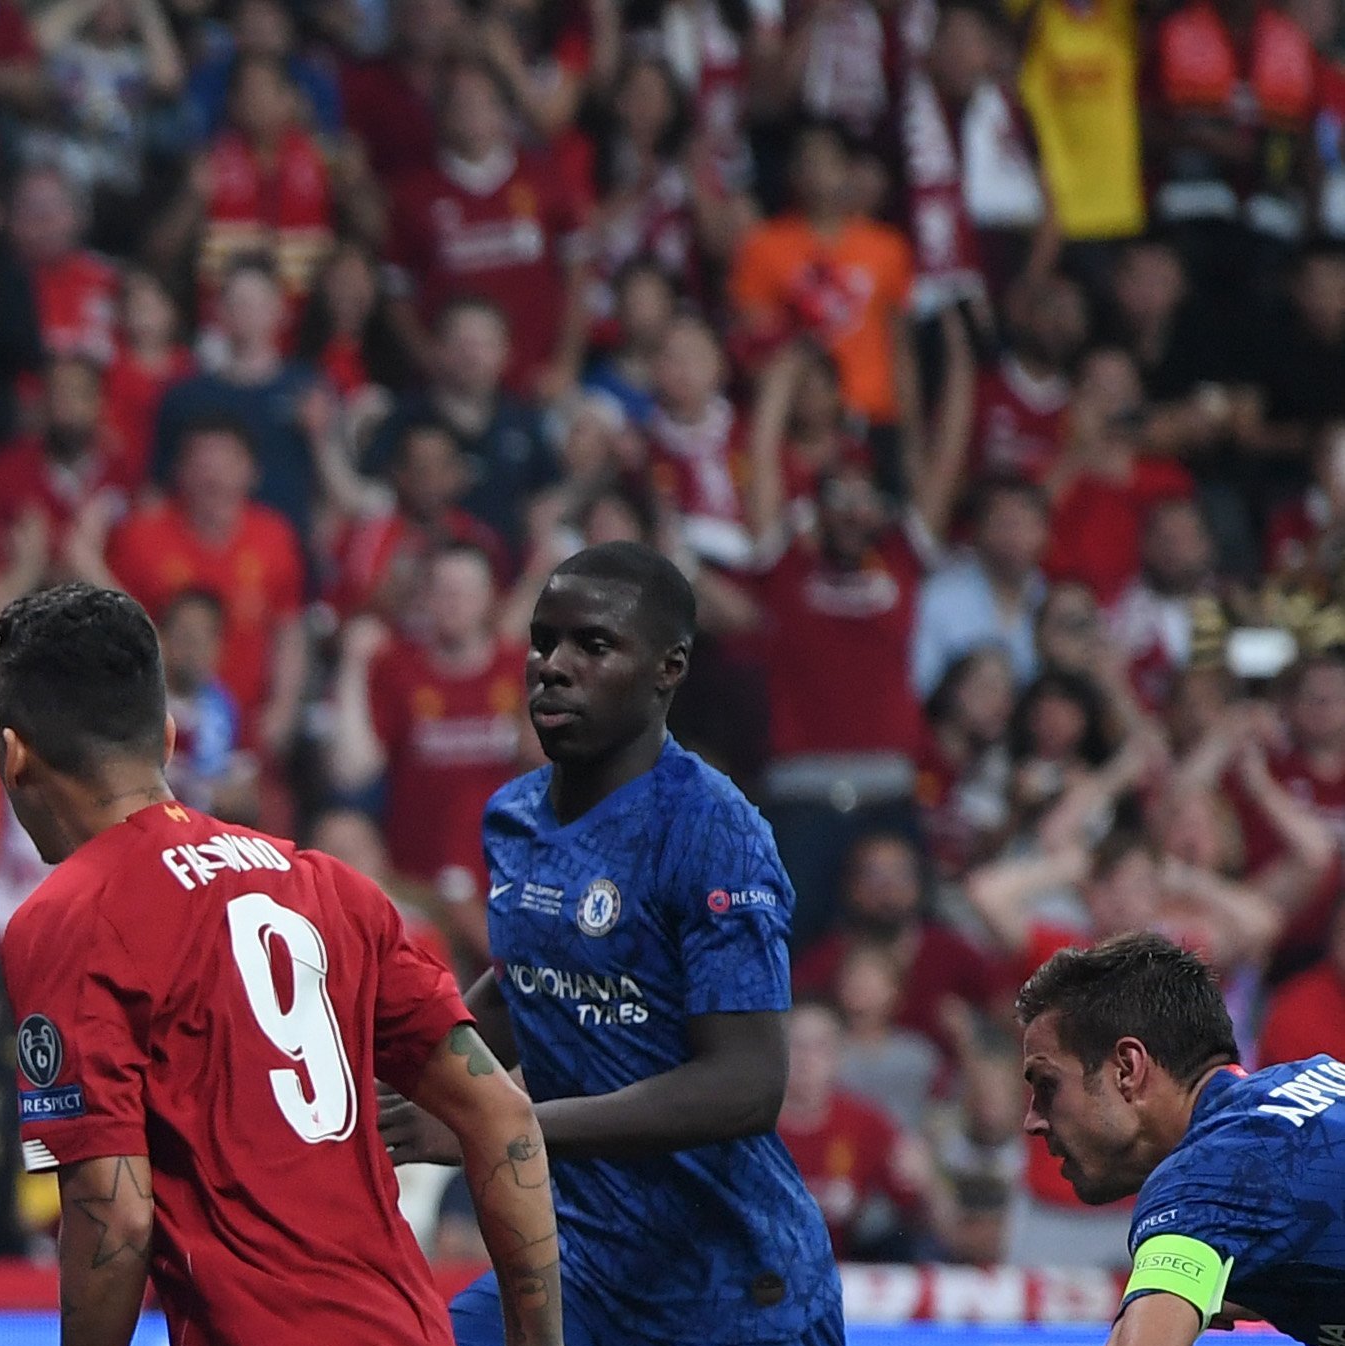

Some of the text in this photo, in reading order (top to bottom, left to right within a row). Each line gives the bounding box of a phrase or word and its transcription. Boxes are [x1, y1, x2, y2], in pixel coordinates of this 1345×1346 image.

[507, 963, 643, 1001] YOKOHAMA
[226, 892, 358, 1144] 9
[576, 1002, 649, 1026] TYRES
[36, 1049, 48, 1068] 6
